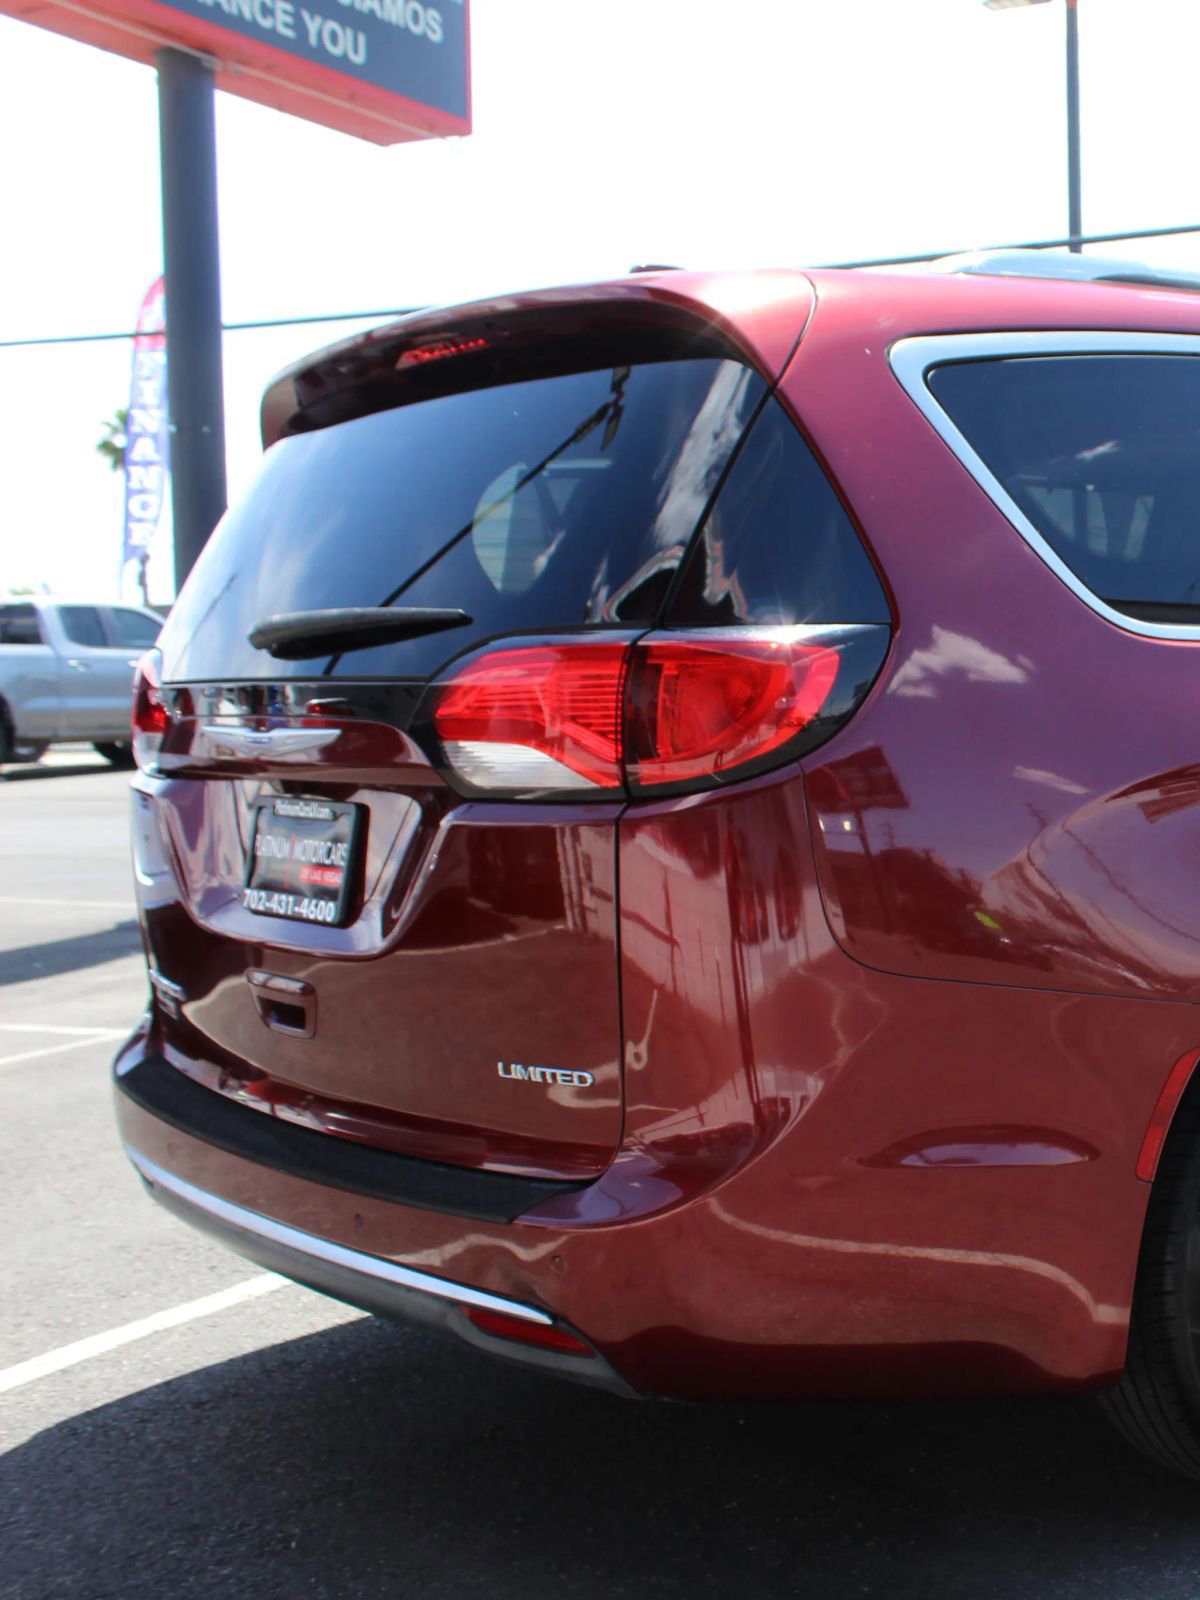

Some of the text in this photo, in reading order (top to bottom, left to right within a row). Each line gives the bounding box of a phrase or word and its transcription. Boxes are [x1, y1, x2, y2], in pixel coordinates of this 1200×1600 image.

[300, 8, 366, 65] YOU
[337, 0, 443, 44] AMOS
[243, 888, 337, 922] 702-431-4600
[497, 1061, 593, 1087] LIMITED
